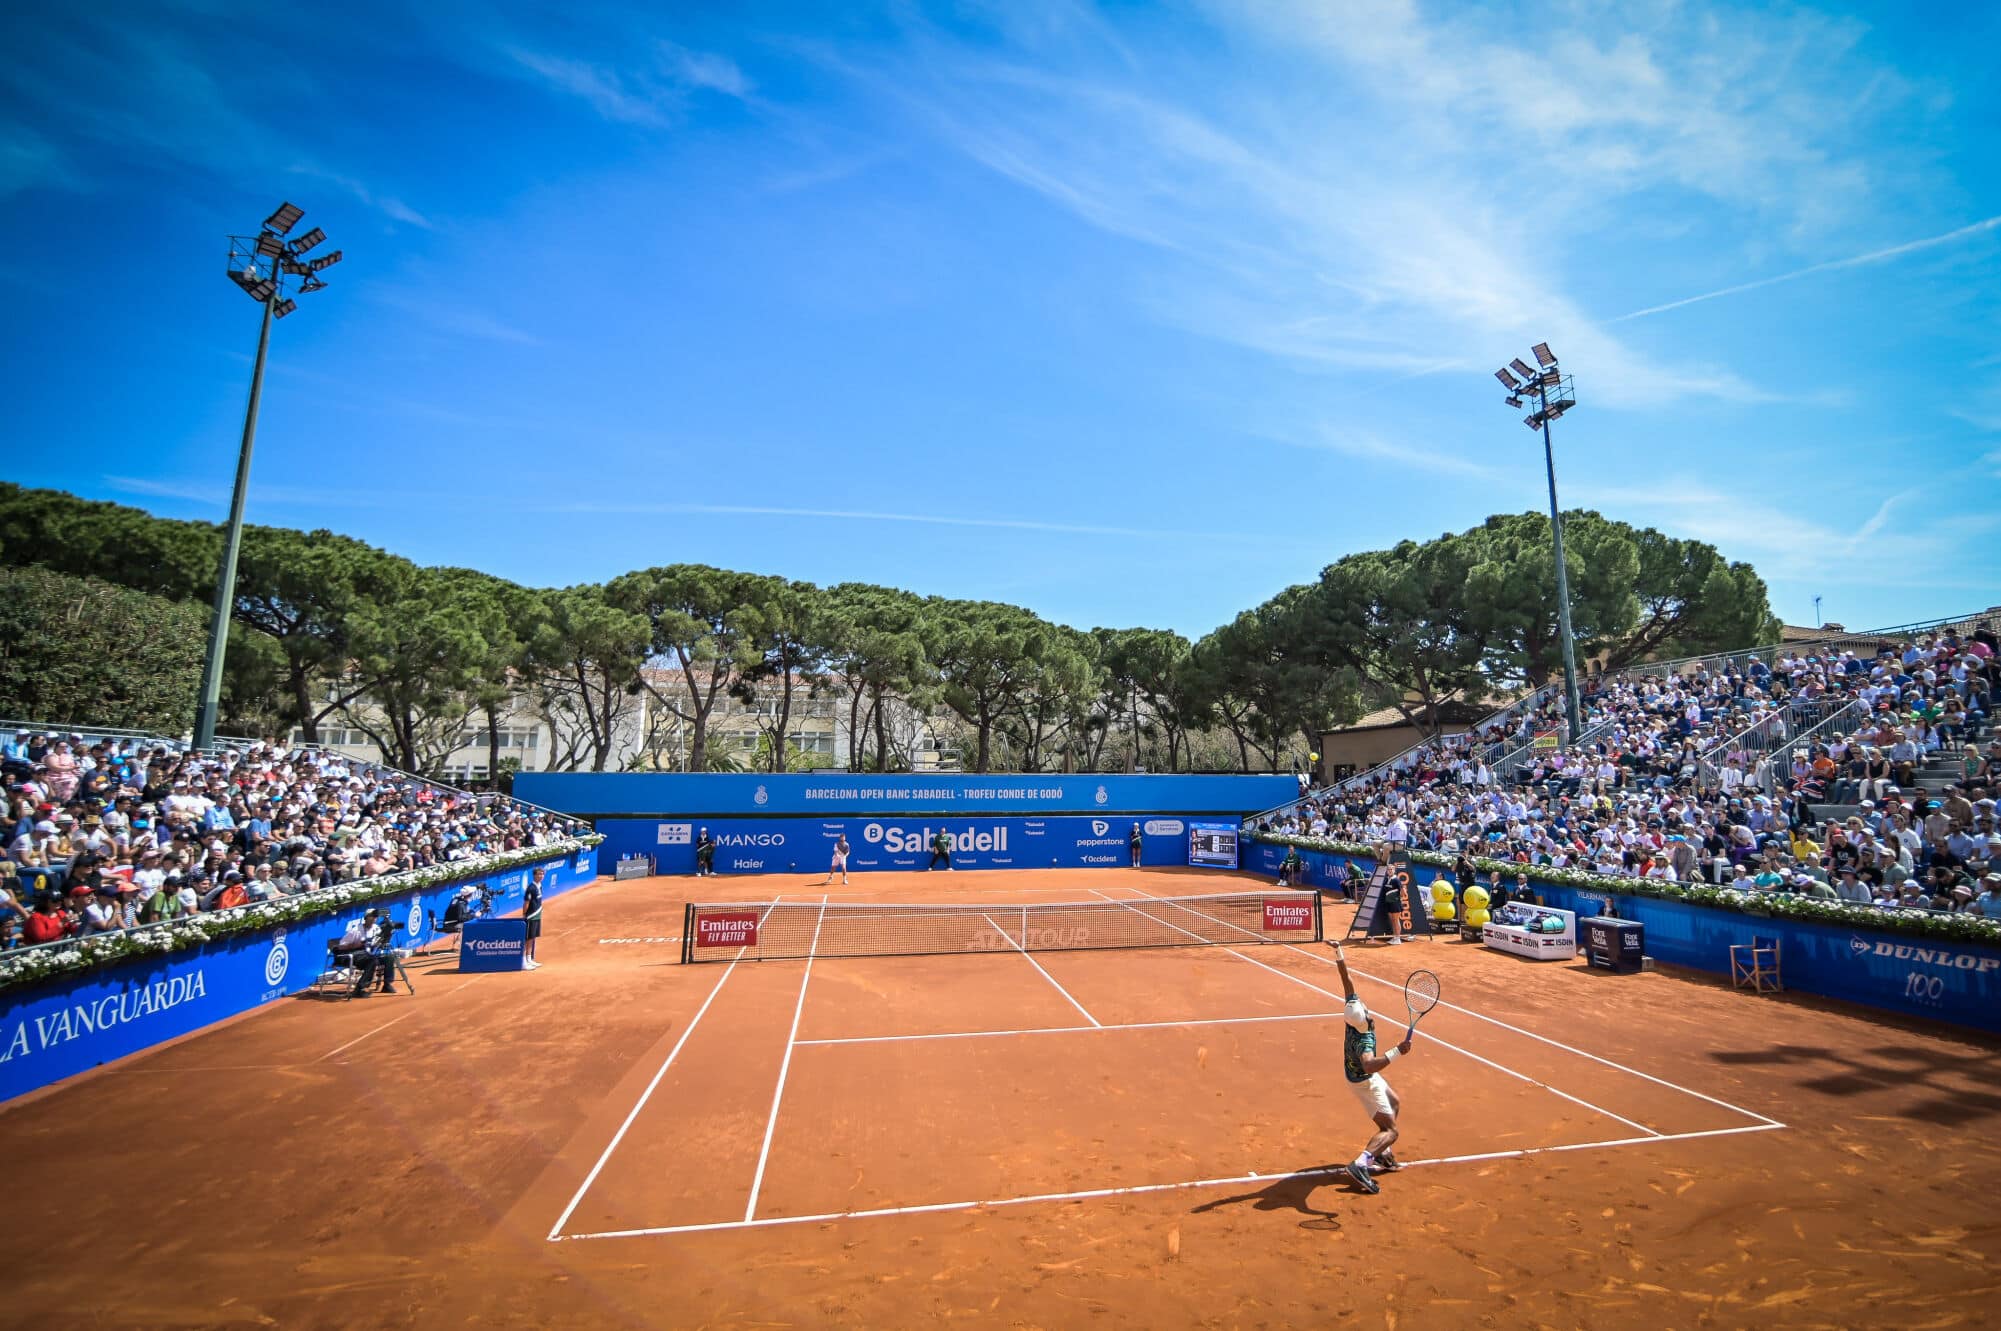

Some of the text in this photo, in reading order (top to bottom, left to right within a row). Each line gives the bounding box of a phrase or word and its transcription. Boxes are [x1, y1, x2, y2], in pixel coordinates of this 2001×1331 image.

[805, 788, 858, 799] BARCELONA
[861, 788, 884, 799] OPEN
[886, 788, 910, 799] BANC
[912, 788, 955, 799] SABADELL
[964, 788, 995, 799] TROFEU
[997, 788, 1025, 799] CONDE
[1027, 788, 1038, 799] DE
[1040, 786, 1063, 799] GODÓ
[716, 833, 785, 847] MANGO
[884, 827, 1008, 853] Sabadell
[1076, 838, 1124, 847] pepperstone
[734, 858, 764, 869] Haier
[1088, 855, 1117, 863] Occident
[1266, 905, 1309, 916] Emirates
[701, 919, 754, 932] Emirates
[1272, 915, 1303, 926] FLY BETTER
[708, 931, 747, 942] FLY BETTER
[1494, 931, 1509, 941] ISDIN
[477, 939, 522, 950] Occident
[1522, 937, 1539, 949] ISDIN
[1555, 938, 1574, 947] ISDIN
[1872, 941, 2001, 973] DUNLOP
[1904, 971, 1944, 1000] 100
[35, 969, 206, 1050] VANGUARDIA
